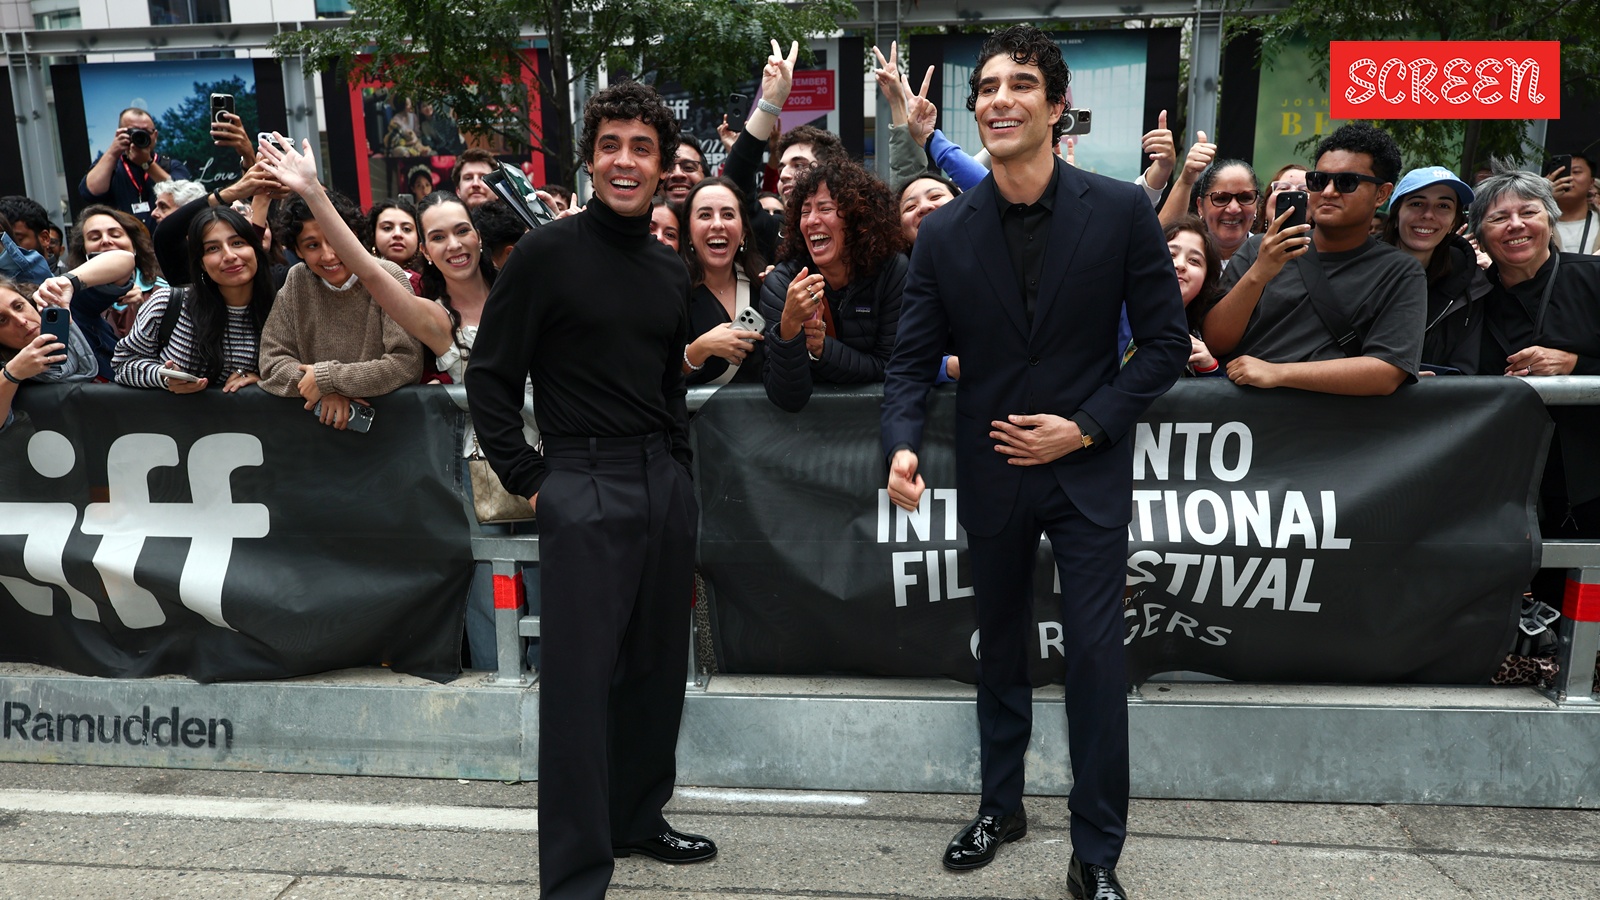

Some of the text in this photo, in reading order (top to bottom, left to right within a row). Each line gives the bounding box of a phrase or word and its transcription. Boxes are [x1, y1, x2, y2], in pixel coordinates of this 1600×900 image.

[788, 95, 812, 105] 2026
[792, 77, 827, 87] TEMBER
[816, 86, 828, 95] 20
[196, 157, 237, 183] Love
[877, 486, 1351, 550] INTTIONAL
[892, 549, 1322, 613] FIL STIVAL
[1037, 603, 1233, 659] RGERS
[3, 701, 234, 749] Ramudden
